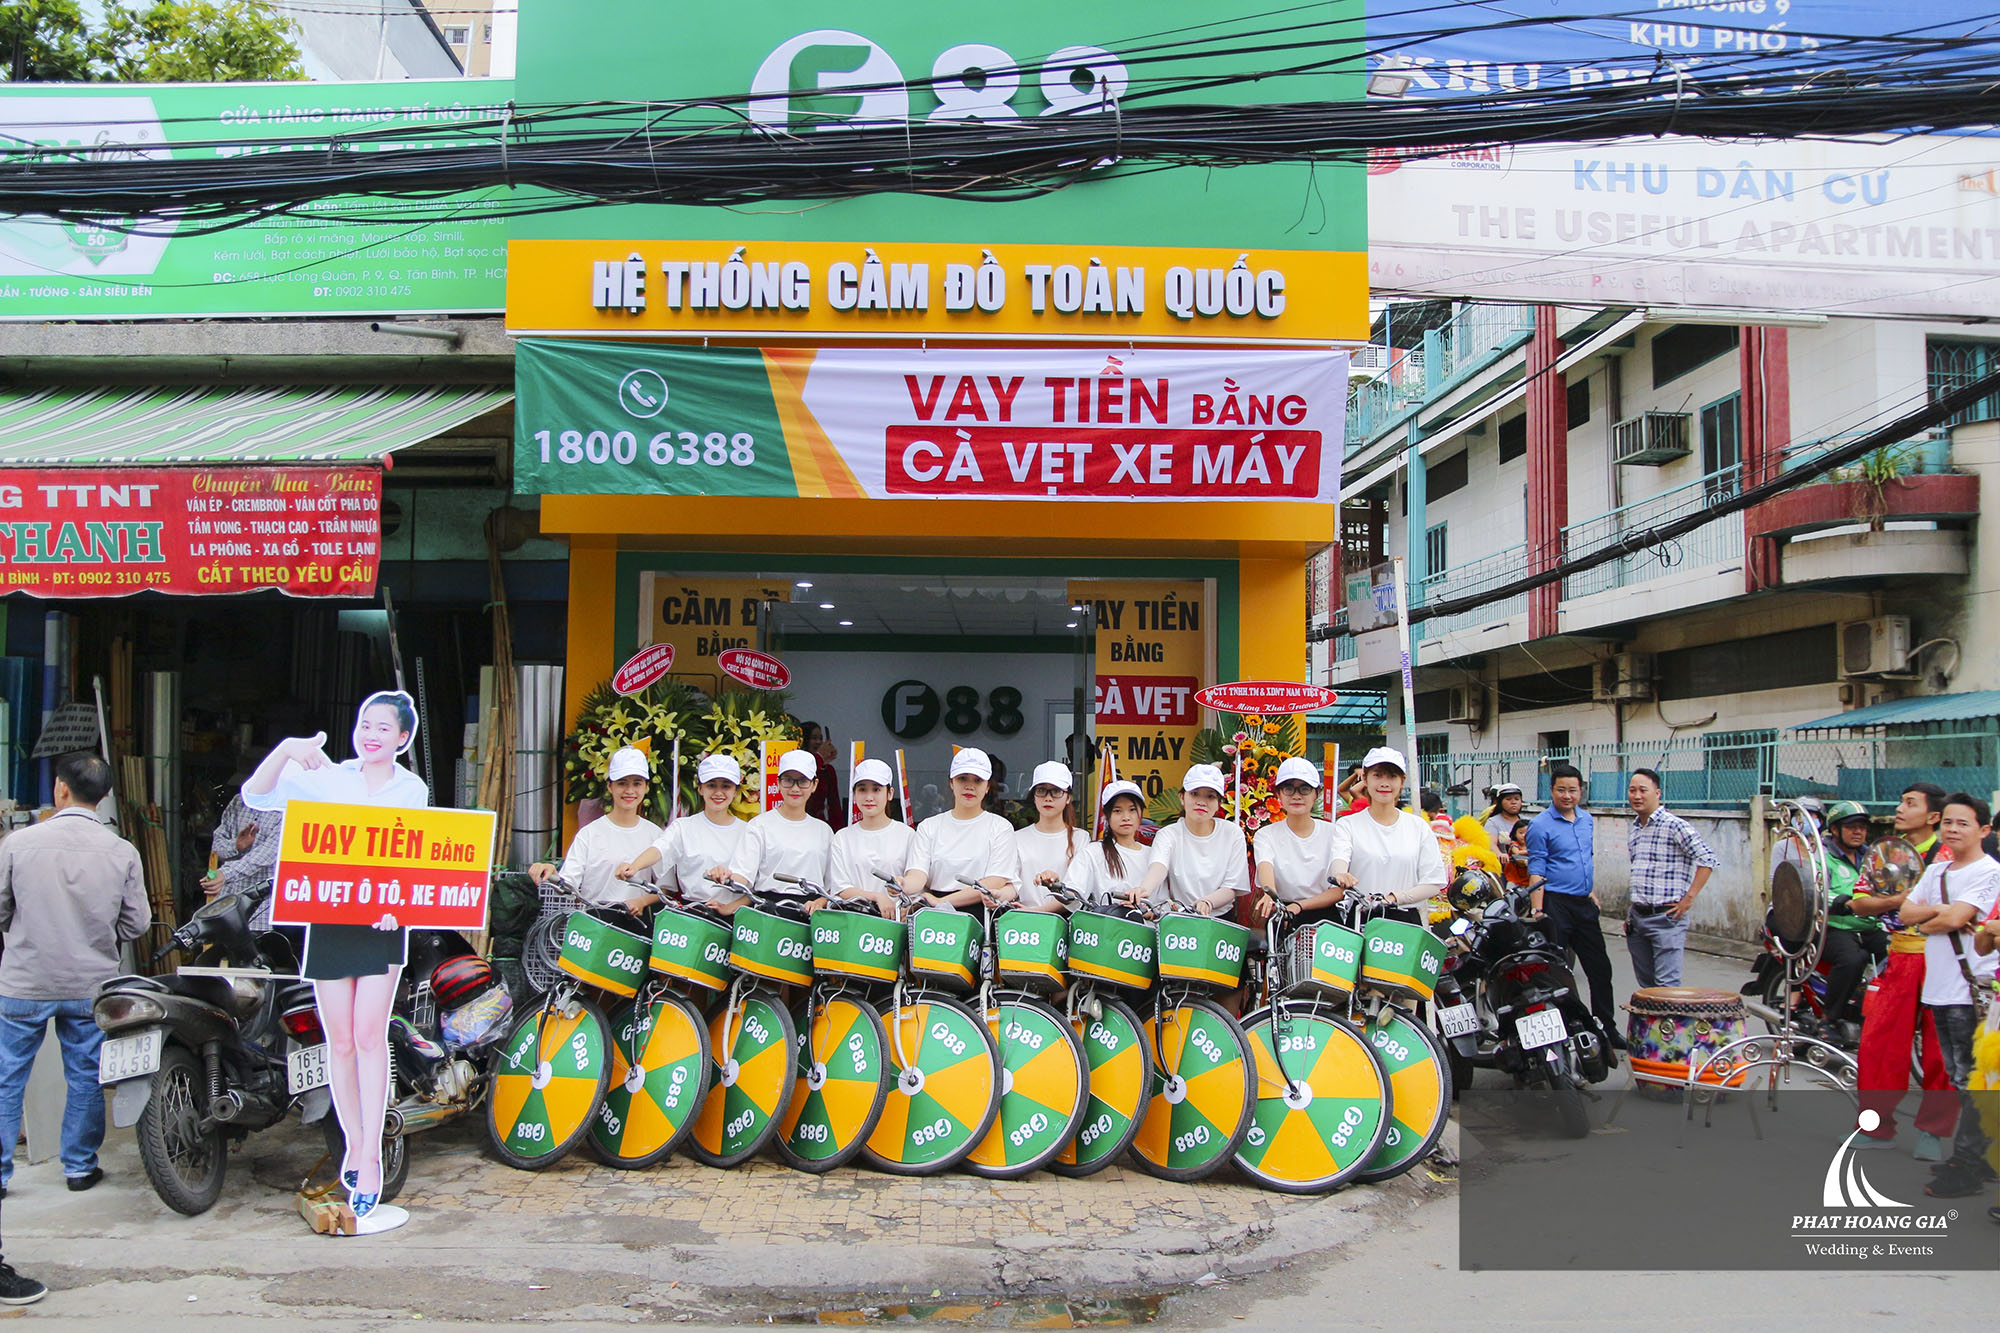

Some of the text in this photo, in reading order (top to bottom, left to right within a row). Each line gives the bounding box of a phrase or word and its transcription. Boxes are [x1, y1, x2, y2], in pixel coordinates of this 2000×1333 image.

[1630, 21, 1787, 52] KHU PHỐ
[219, 104, 261, 125] CỬA
[267, 105, 324, 124] HÀNG
[330, 107, 395, 122] TRANG
[401, 101, 428, 121] TRÍ
[1451, 161, 1500, 169] CORPORATION
[1573, 159, 1889, 206] KHU DÂN CƯ
[1451, 204, 1536, 240] THE
[1555, 208, 1719, 250] USEFUL
[88, 235, 105, 246] 50
[294, 250, 326, 260] cách
[29, 281, 152, 297] TƯỜNG SÀN SIÊU BỀN
[213, 272, 236, 283] ĐC:
[288, 271, 318, 284] Long
[593, 246, 1286, 321] HỆ THỐNG CẦM ĐỒ TOÀN QUỐC
[313, 285, 412, 297] ĐT: 0902 310 475
[903, 354, 1307, 426] VAY TIỀN BẰNG
[534, 430, 755, 466] 1800 6388
[902, 428, 1307, 495] CÀ VẸT XE MÁY
[266, 473, 309, 493] Mua
[37, 484, 160, 508] TTNT
[186, 494, 378, 513] VÁN ÉP CREMBRON VÁN CỐT PHA ĐỎ
[214, 520, 242, 534] VONG
[250, 520, 286, 537] THẠCH
[288, 520, 309, 534] CAO
[318, 515, 348, 534] TRẦN
[351, 518, 378, 536] NHỰA
[190, 543, 206, 556] LA
[209, 540, 252, 556] PHÔNG
[263, 543, 279, 556] XA
[312, 543, 343, 556] TOLE
[8, 570, 171, 585] BÌNH ĐT: 0902 310 475
[198, 558, 373, 584] CẮT THEO YÊU CẦU
[662, 587, 731, 626] CẦM
[1134, 591, 1200, 631] TIỀN
[1111, 634, 1164, 663] BẰNG
[1132, 686, 1190, 722] VẸT
[1212, 687, 1227, 696] CTY
[1266, 687, 1285, 697] XDNT
[1286, 687, 1301, 697] NAM
[1302, 686, 1319, 698] VIỆT
[881, 679, 1025, 739] F88
[1127, 731, 1185, 761] MÁY
[301, 816, 476, 863] VAY TIỀN BẰNG
[284, 875, 482, 908] CÀ VẸT Ô TÔ, XE MÁY
[568, 929, 592, 951] F88
[658, 928, 688, 948] F88
[736, 925, 759, 944] F88
[814, 927, 840, 943] F88
[859, 932, 894, 955] F88
[920, 928, 956, 946] F88
[1004, 929, 1040, 947] F88
[1073, 928, 1099, 947] F88
[1164, 933, 1198, 950] F88
[1368, 936, 1404, 956] F88
[607, 948, 643, 974] F88
[776, 936, 812, 961] F88
[1117, 938, 1152, 963] F88
[1215, 939, 1241, 963] F88
[1320, 941, 1355, 963] F88
[744, 1015, 769, 1045] F88
[931, 1022, 967, 1056] F88
[1005, 1021, 1043, 1050] F88
[1090, 1021, 1119, 1050] F88
[1191, 1027, 1223, 1064] F88
[1371, 1030, 1409, 1062] F88
[109, 1055, 150, 1079] 9458
[1009, 1112, 1048, 1147] F88
[1081, 1113, 1113, 1146] F88
[1175, 1125, 1210, 1153] F88
[1331, 1106, 1364, 1149] F88
